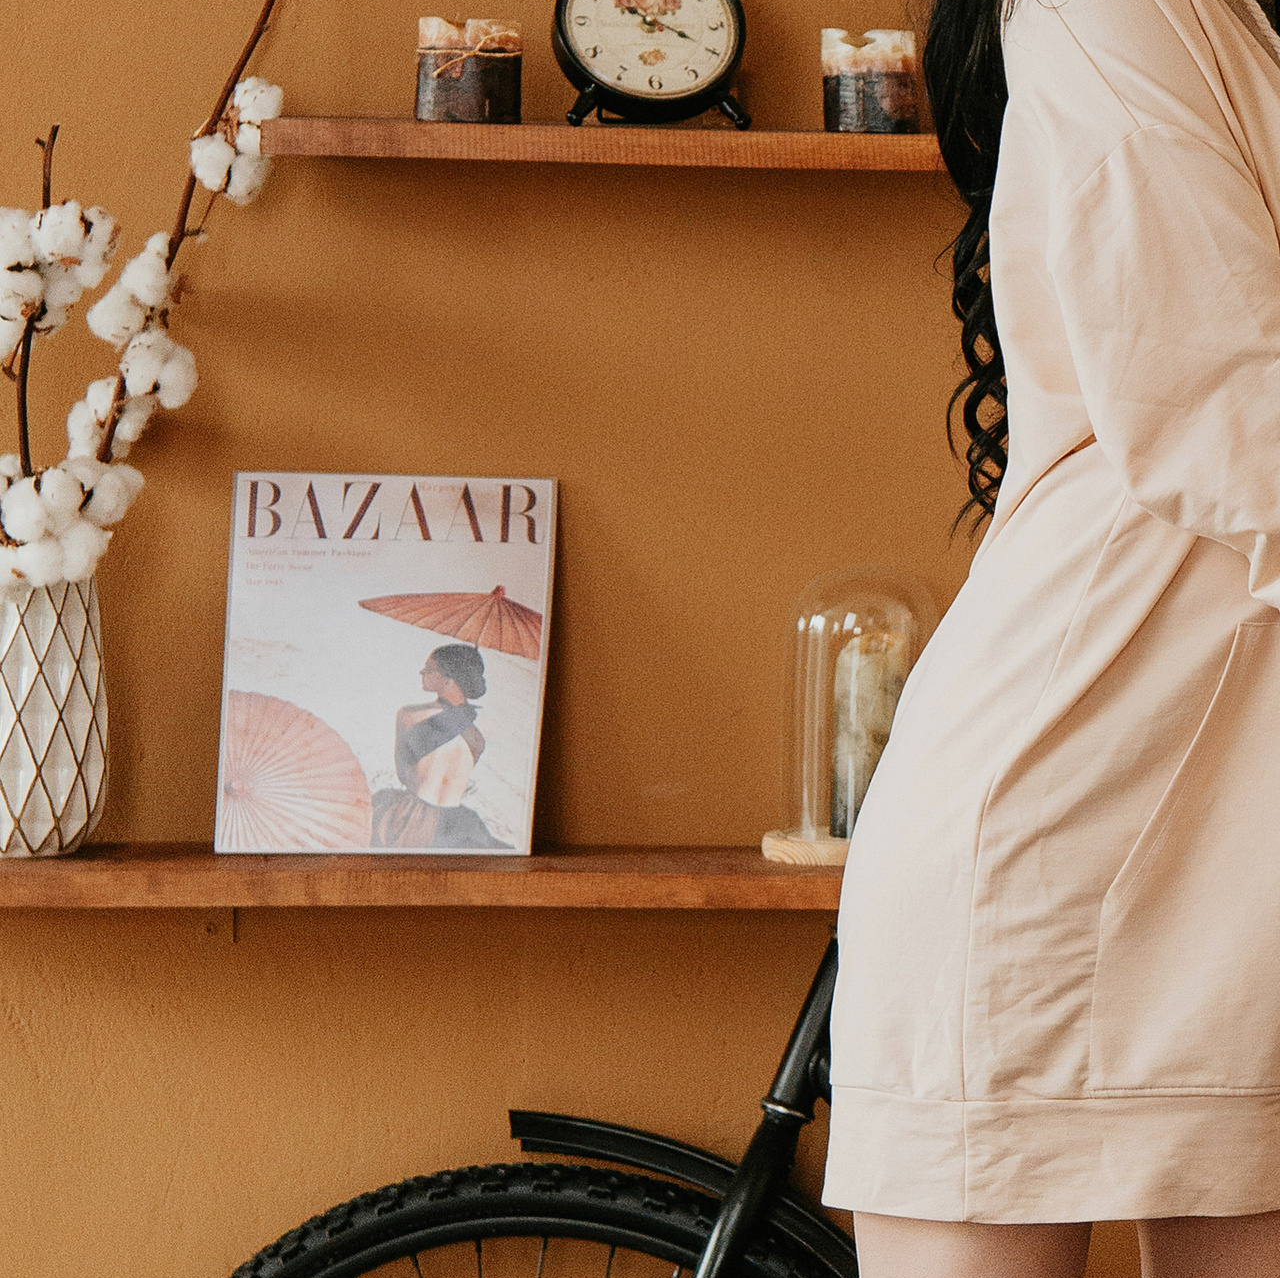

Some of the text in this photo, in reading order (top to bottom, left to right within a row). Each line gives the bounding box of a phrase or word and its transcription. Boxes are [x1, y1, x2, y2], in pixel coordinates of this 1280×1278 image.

[574, 15, 591, 27] 9
[708, 20, 725, 31] 3
[585, 45, 603, 59] 8
[705, 46, 721, 61] 4
[616, 64, 629, 81] 7
[684, 65, 699, 82] 5
[648, 74, 663, 91] 6
[242, 479, 546, 545] BAZAAR
